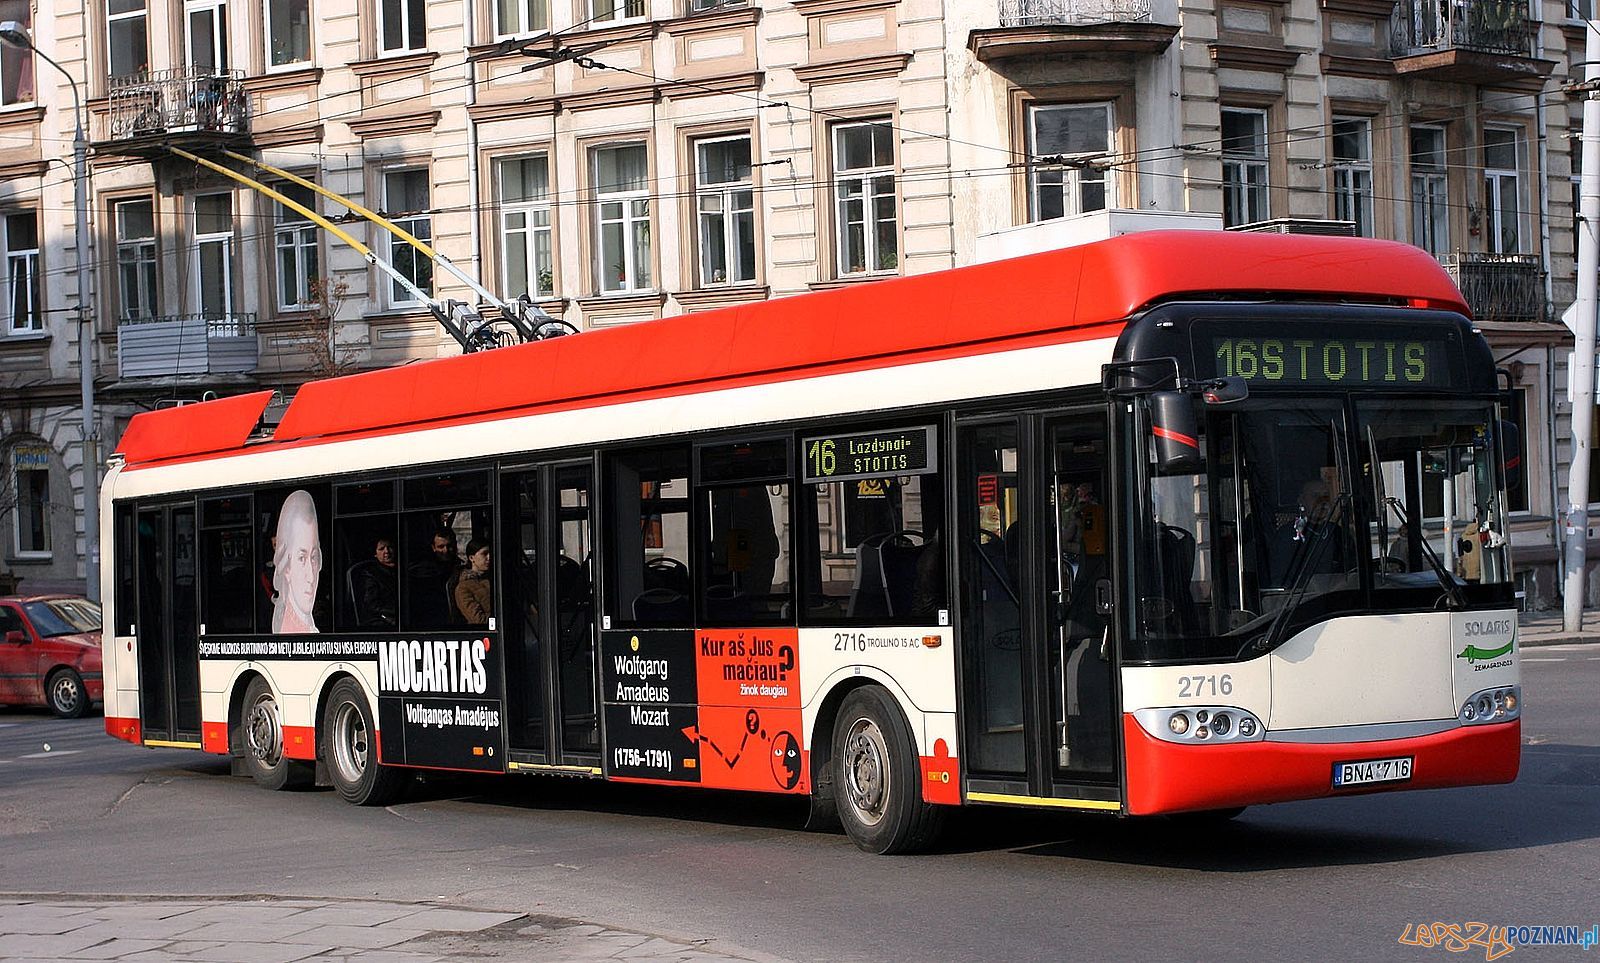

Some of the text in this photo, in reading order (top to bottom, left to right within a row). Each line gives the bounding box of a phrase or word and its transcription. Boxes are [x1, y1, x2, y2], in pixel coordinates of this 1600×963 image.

[849, 435, 911, 455] Lazdynai-
[809, 439, 836, 476] 16
[854, 454, 907, 473] STOTIS
[1465, 620, 1510, 637] SOLARIS
[701, 632, 774, 656] Kur aš Jus
[834, 633, 920, 651] 2716 TROLLINO 15 AC
[378, 640, 487, 694] MOCARTAS
[614, 655, 668, 680] Wolfgang
[616, 681, 670, 702] Amadeus
[740, 684, 788, 698] žinok daugiau
[1178, 674, 1233, 698] 2716
[455, 705, 499, 731] Amadėjus
[630, 705, 670, 726] Mozart
[1343, 763, 1374, 783] BNA
[1383, 760, 1409, 779] 716
